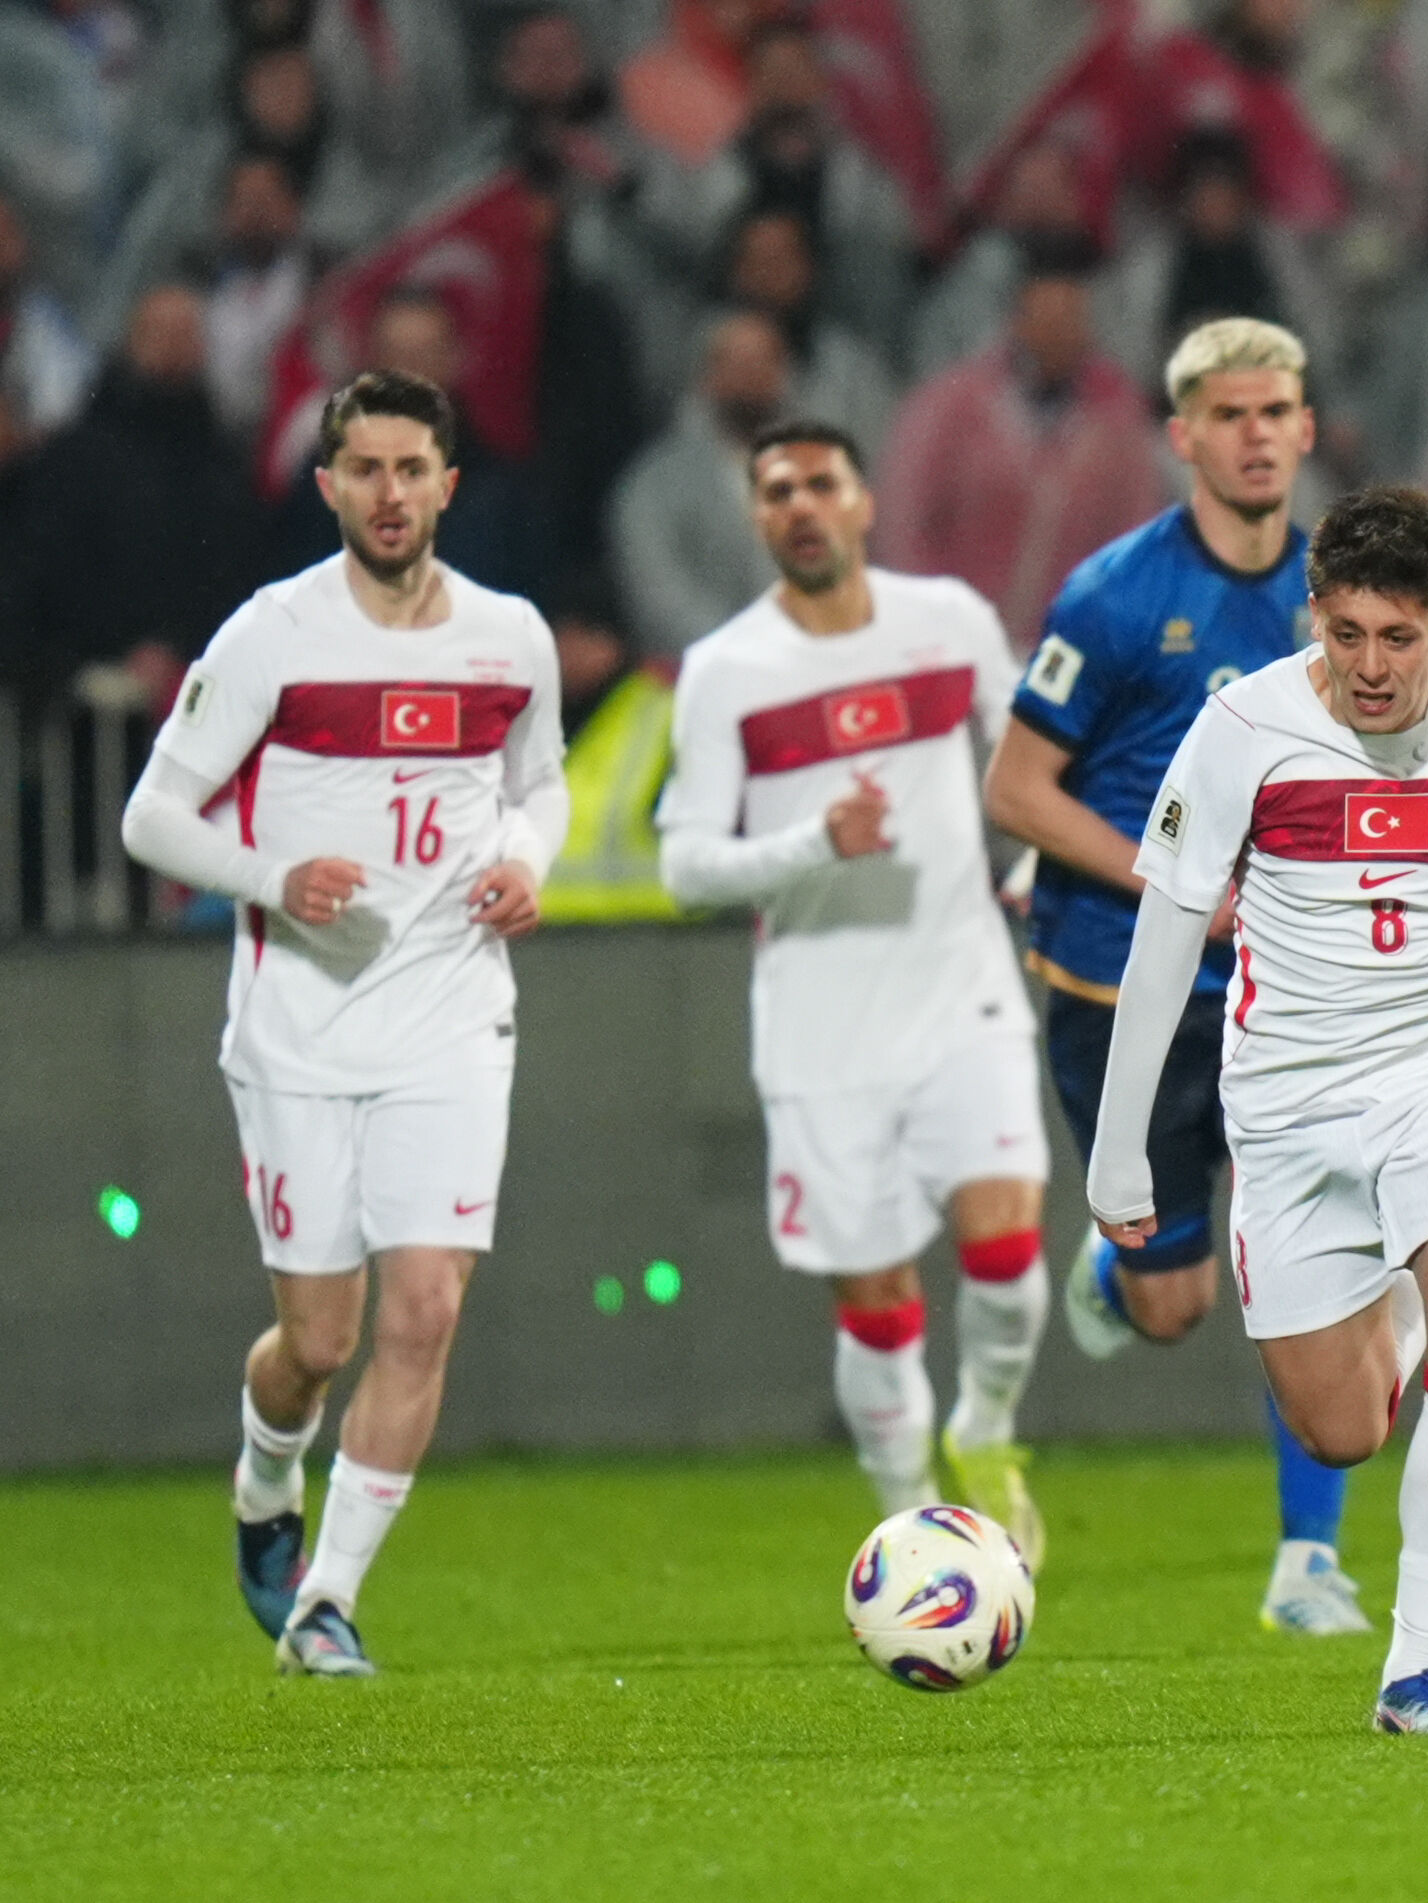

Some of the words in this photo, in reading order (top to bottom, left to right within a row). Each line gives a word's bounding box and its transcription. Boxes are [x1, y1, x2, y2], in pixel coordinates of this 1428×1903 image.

[389, 796, 443, 867] 16
[1371, 898, 1408, 956] 8
[258, 1165, 292, 1240] 16
[777, 1170, 806, 1236] 2
